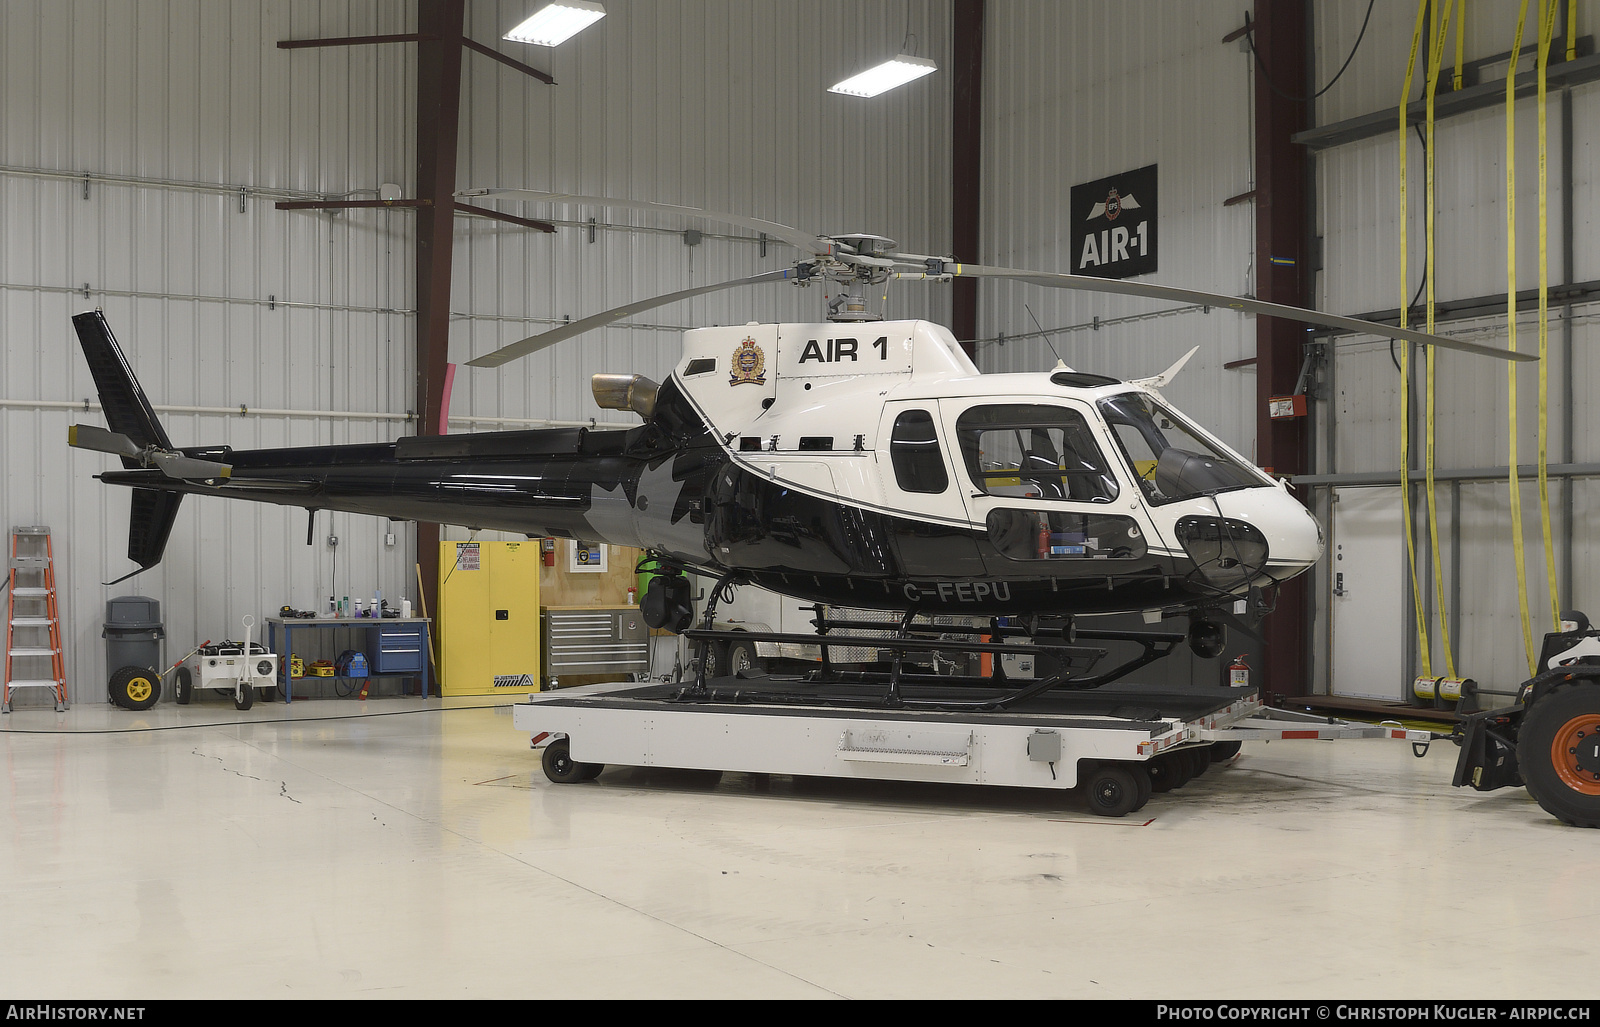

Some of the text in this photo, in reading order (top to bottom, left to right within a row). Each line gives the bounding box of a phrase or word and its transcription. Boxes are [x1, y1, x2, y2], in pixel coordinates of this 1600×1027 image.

[1108, 202, 1118, 211] EPS
[1080, 220, 1147, 269] AIR-1
[799, 337, 887, 363] AIR 1
[903, 581, 1011, 602] C-FEPU
